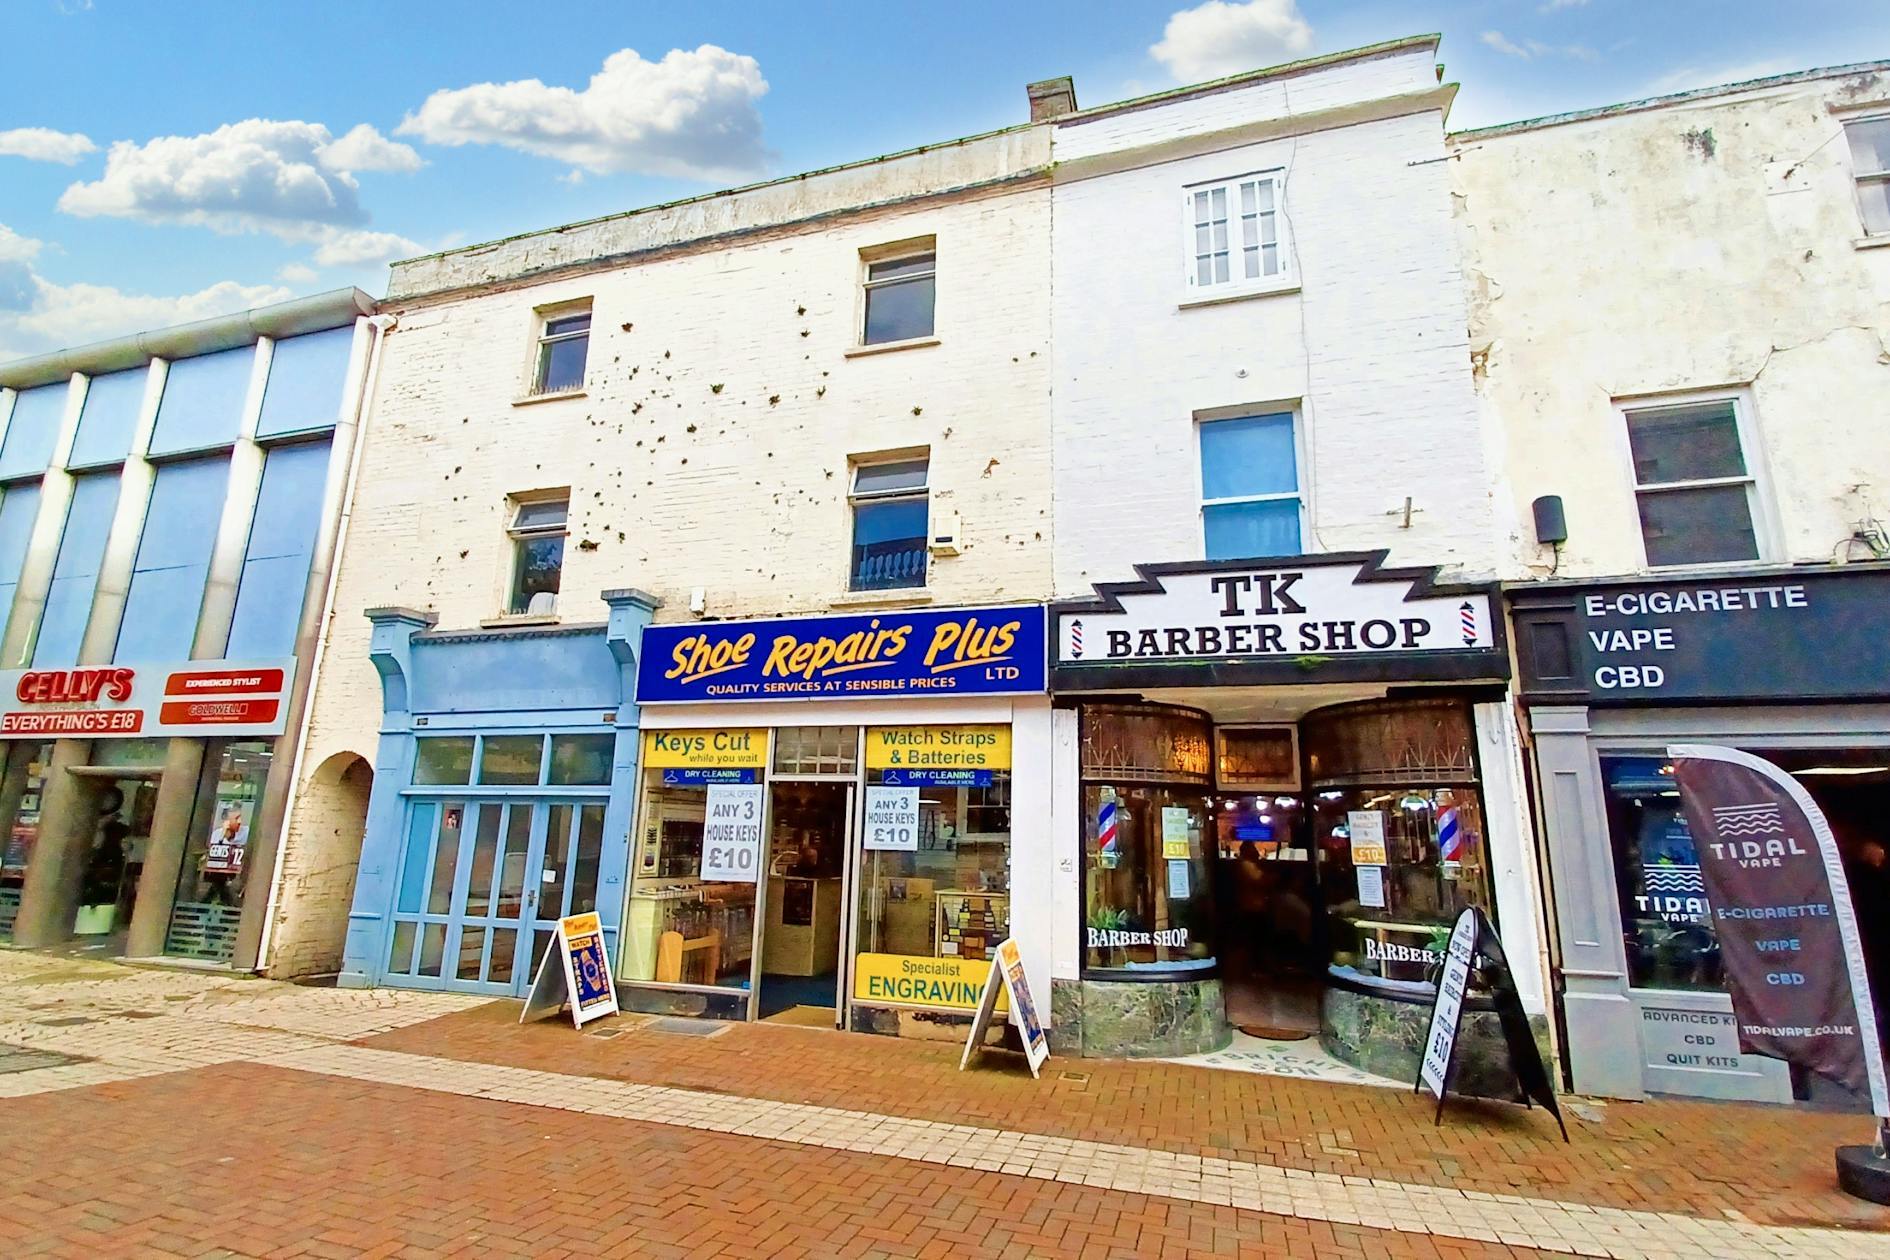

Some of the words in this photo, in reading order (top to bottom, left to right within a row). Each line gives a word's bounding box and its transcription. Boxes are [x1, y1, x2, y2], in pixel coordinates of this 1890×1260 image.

[1211, 572, 1307, 617] TK
[1585, 585, 1808, 617] E-CIGARETTE
[1107, 624, 1287, 658] BARBER
[1299, 618, 1431, 652] SHOP
[1588, 628, 1675, 652] VAPE
[664, 632, 756, 679] Shoe
[762, 618, 913, 680] Repairs
[923, 617, 1021, 666] Plus
[232, 677, 261, 686] STYLIST
[985, 666, 1020, 681] LTD
[1594, 665, 1665, 689] CBD
[16, 669, 135, 703] CELLY'S
[706, 683, 759, 696] QUALITY
[763, 682, 821, 693] SERVICES
[824, 681, 841, 691] AT
[845, 679, 906, 691] SENSIBLE
[909, 677, 956, 689] PRICES
[1, 713, 108, 731] EVERYTHING'S
[110, 712, 136, 729] £18
[654, 732, 705, 756] Keys
[713, 731, 751, 751] Cut
[881, 730, 933, 745] Watch
[940, 729, 996, 748] Straps
[689, 753, 714, 763] while
[716, 756, 735, 765] you
[738, 753, 758, 763] wait
[890, 749, 902, 764] &
[908, 749, 986, 764] Batteries
[684, 770, 700, 778] DRY
[702, 770, 741, 778] CLEANING
[908, 771, 927, 779] DRY
[929, 771, 975, 779] CLEANING
[713, 804, 739, 817] ANY
[744, 801, 754, 819] 3
[875, 801, 897, 810] ANY
[900, 797, 909, 810] 3
[868, 813, 893, 825] HOUSE
[896, 813, 915, 825] KEYS
[707, 825, 733, 841] HOUSE
[735, 825, 758, 842] KEYS
[874, 828, 910, 843] £10
[1709, 838, 1806, 860] TIDAL
[708, 848, 752, 869] £10
[1739, 857, 1782, 868] VAPE
[1660, 913, 1699, 923] VAPE
[1716, 904, 1830, 920] E-CIGARETTE
[1087, 927, 1151, 947] BARBER
[1152, 927, 1188, 948] SHOP
[1755, 938, 1801, 951] VAPE
[1365, 938, 1435, 963] BARBER
[902, 960, 960, 976] Specialist
[1766, 972, 1805, 985] CBD
[1643, 1011, 1719, 1025] ADVANCED
[1742, 1024, 1854, 1038] TIDALVAPE.CO.UK
[1433, 1032, 1449, 1064] £10
[1684, 1034, 1715, 1046] CBD
[1666, 1053, 1701, 1065] QUIT
[1706, 1056, 1739, 1068] KITS
